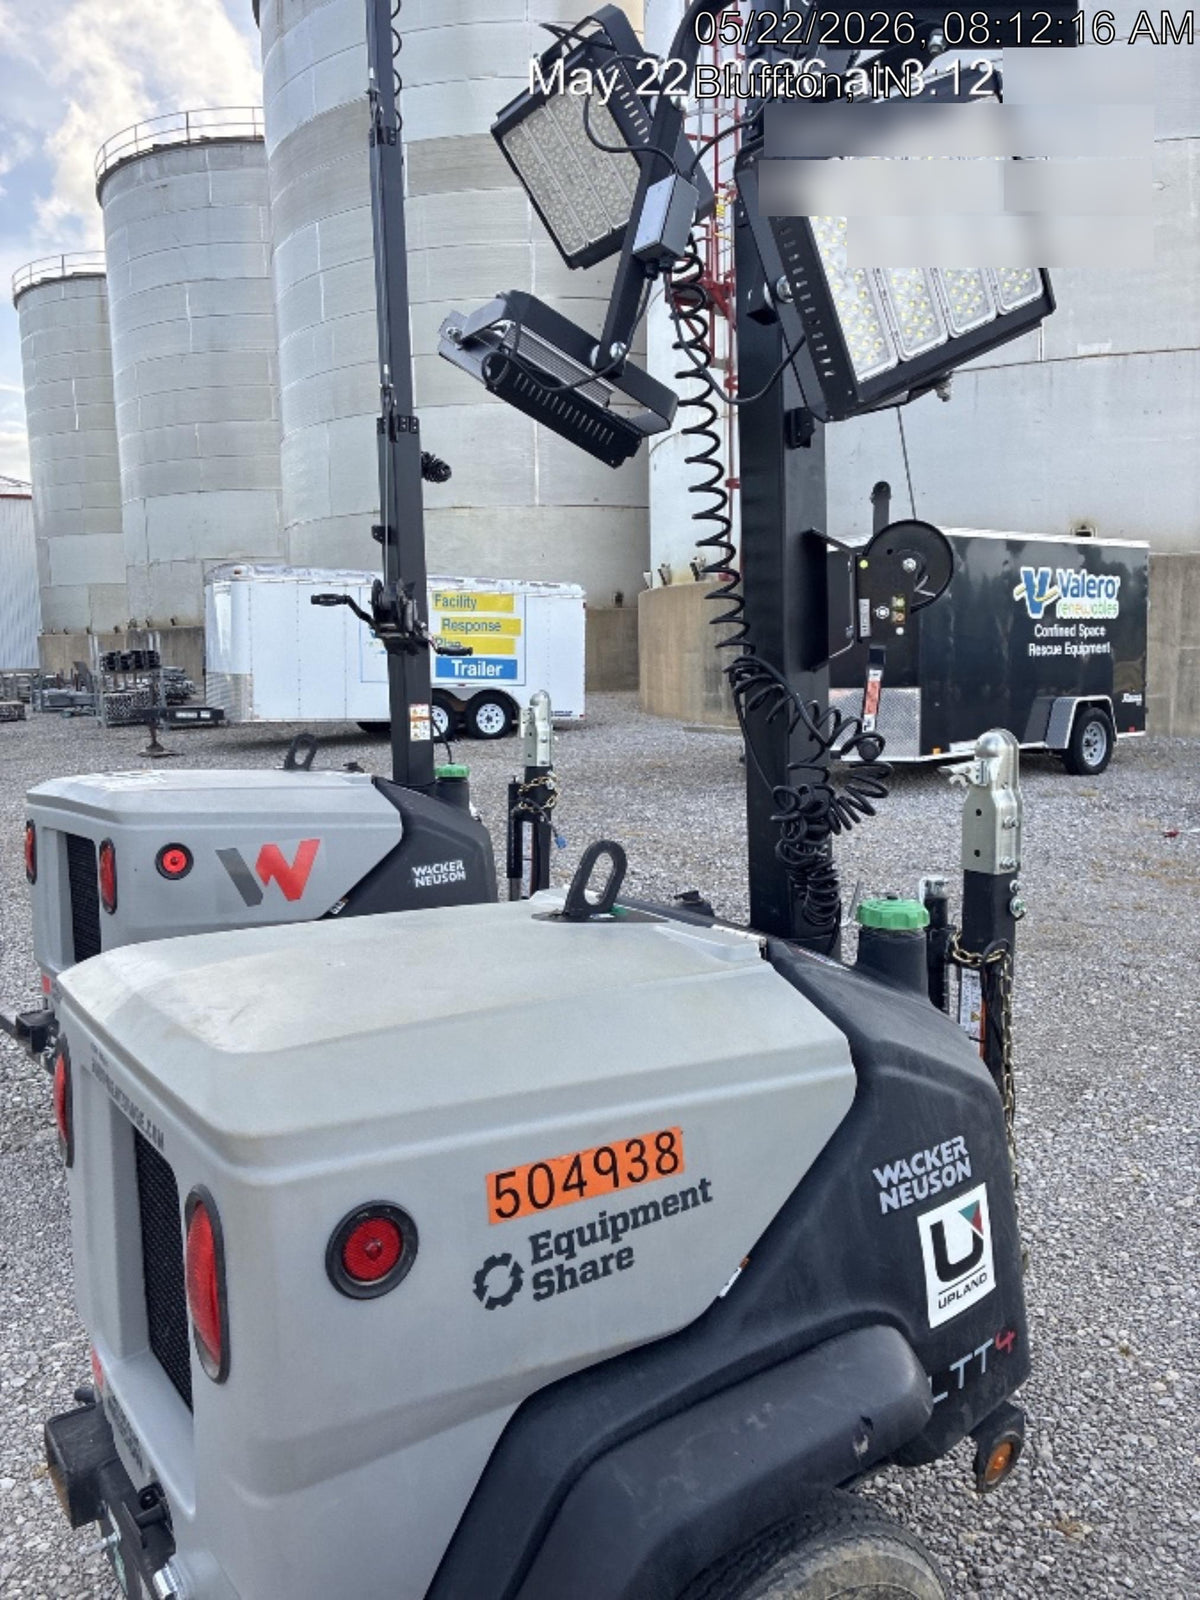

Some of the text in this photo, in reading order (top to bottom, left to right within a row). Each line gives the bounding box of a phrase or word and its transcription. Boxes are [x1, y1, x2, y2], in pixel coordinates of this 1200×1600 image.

[1057, 571, 1118, 598] Valero
[434, 593, 477, 612] Facility
[442, 617, 502, 635] Response
[1034, 623, 1107, 639] Confined Space
[1028, 641, 1111, 658] Rescue Equipment
[451, 659, 503, 677] Trailer
[412, 860, 465, 877] WACKER
[415, 870, 467, 887] NEUSON
[872, 1135, 970, 1188] WACKER
[495, 1131, 680, 1219] 504938
[879, 1156, 972, 1214] NEUSON
[528, 1177, 714, 1266] Equipment
[531, 1245, 636, 1302] Share
[938, 1272, 988, 1310] UPLAND
